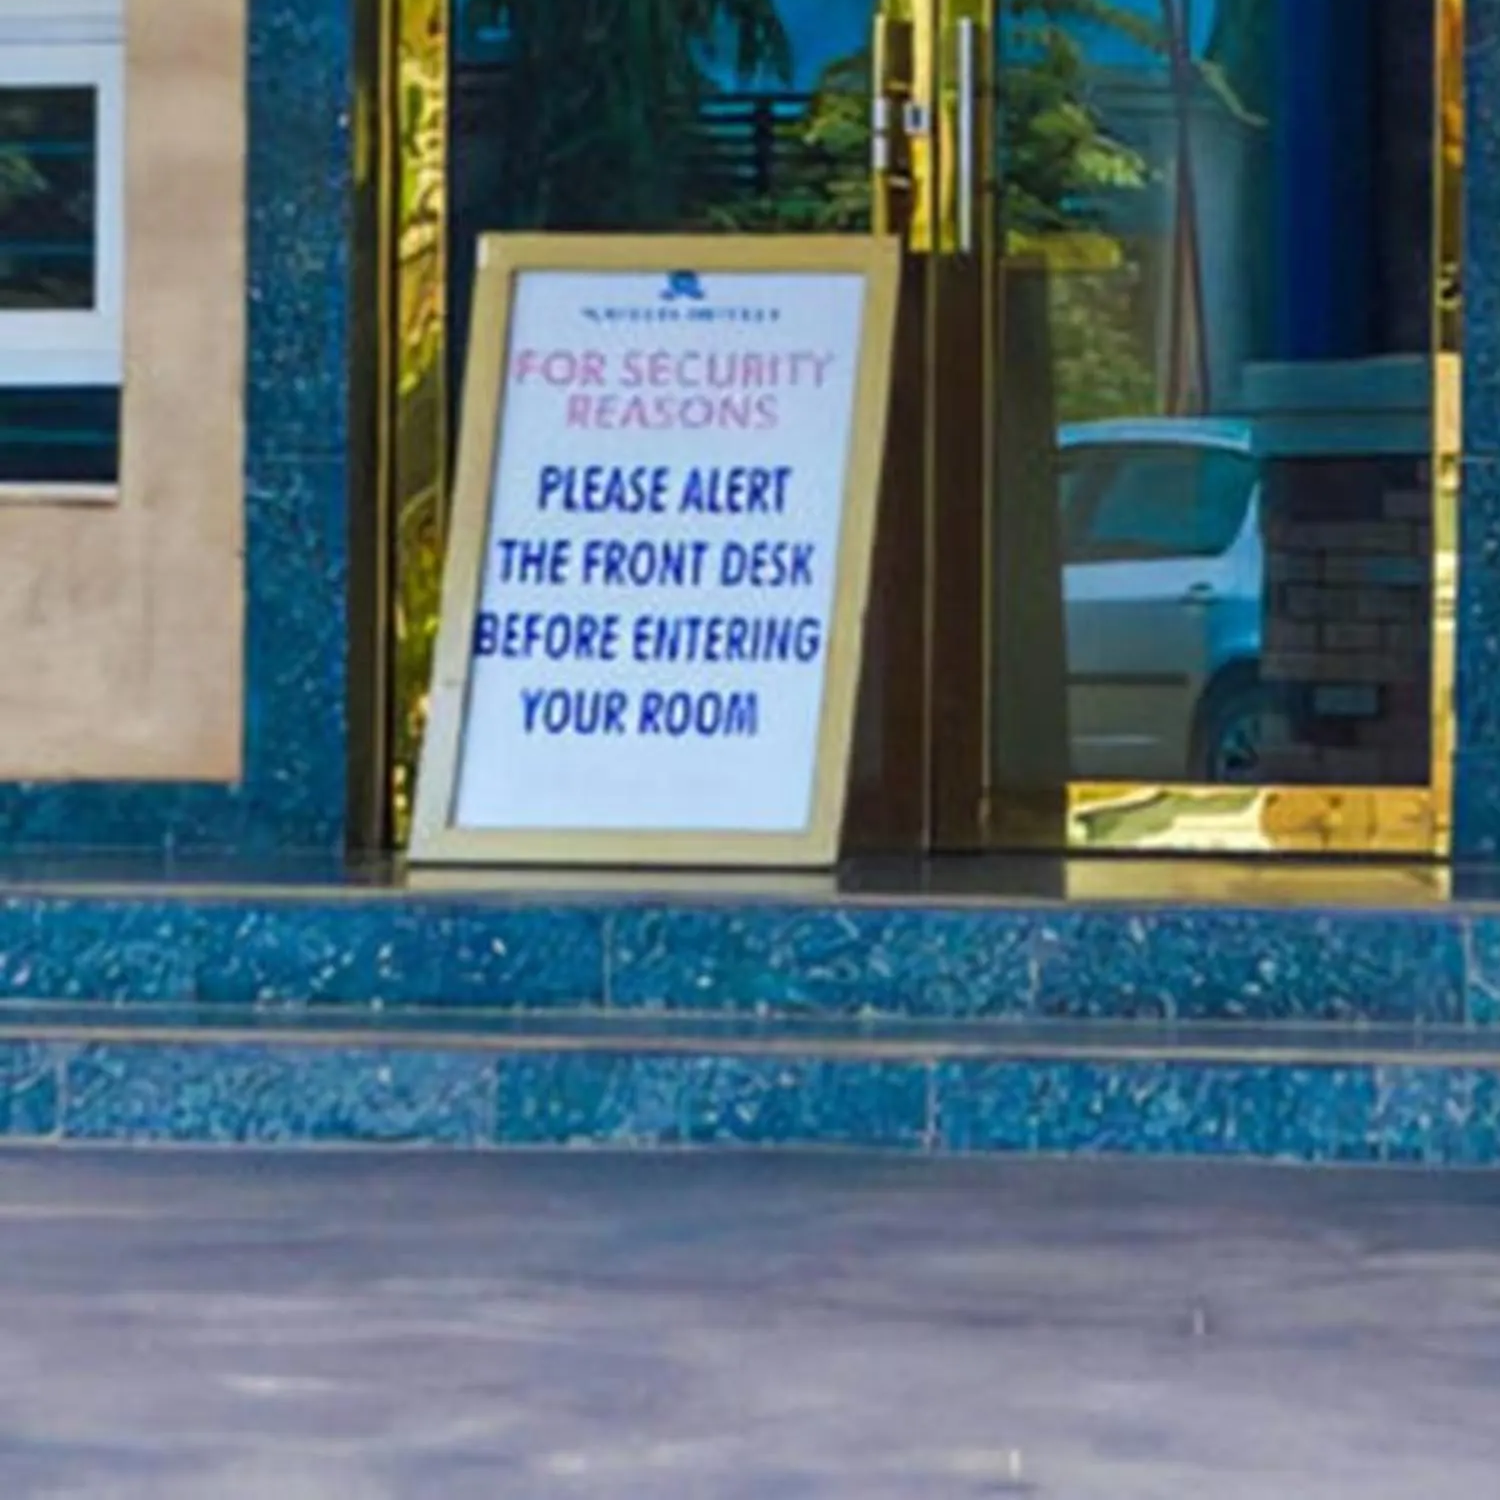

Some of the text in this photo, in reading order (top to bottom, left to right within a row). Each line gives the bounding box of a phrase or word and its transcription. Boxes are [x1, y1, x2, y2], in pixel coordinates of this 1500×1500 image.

[513, 349, 836, 389] FOR SECURITY
[565, 395, 780, 430] REASONS
[537, 465, 794, 515] PLEASE ALERT
[498, 538, 816, 588] THE FRONT DESK
[473, 611, 822, 663] BEFORE ENTERING
[519, 687, 759, 737] YOUR ROOM
